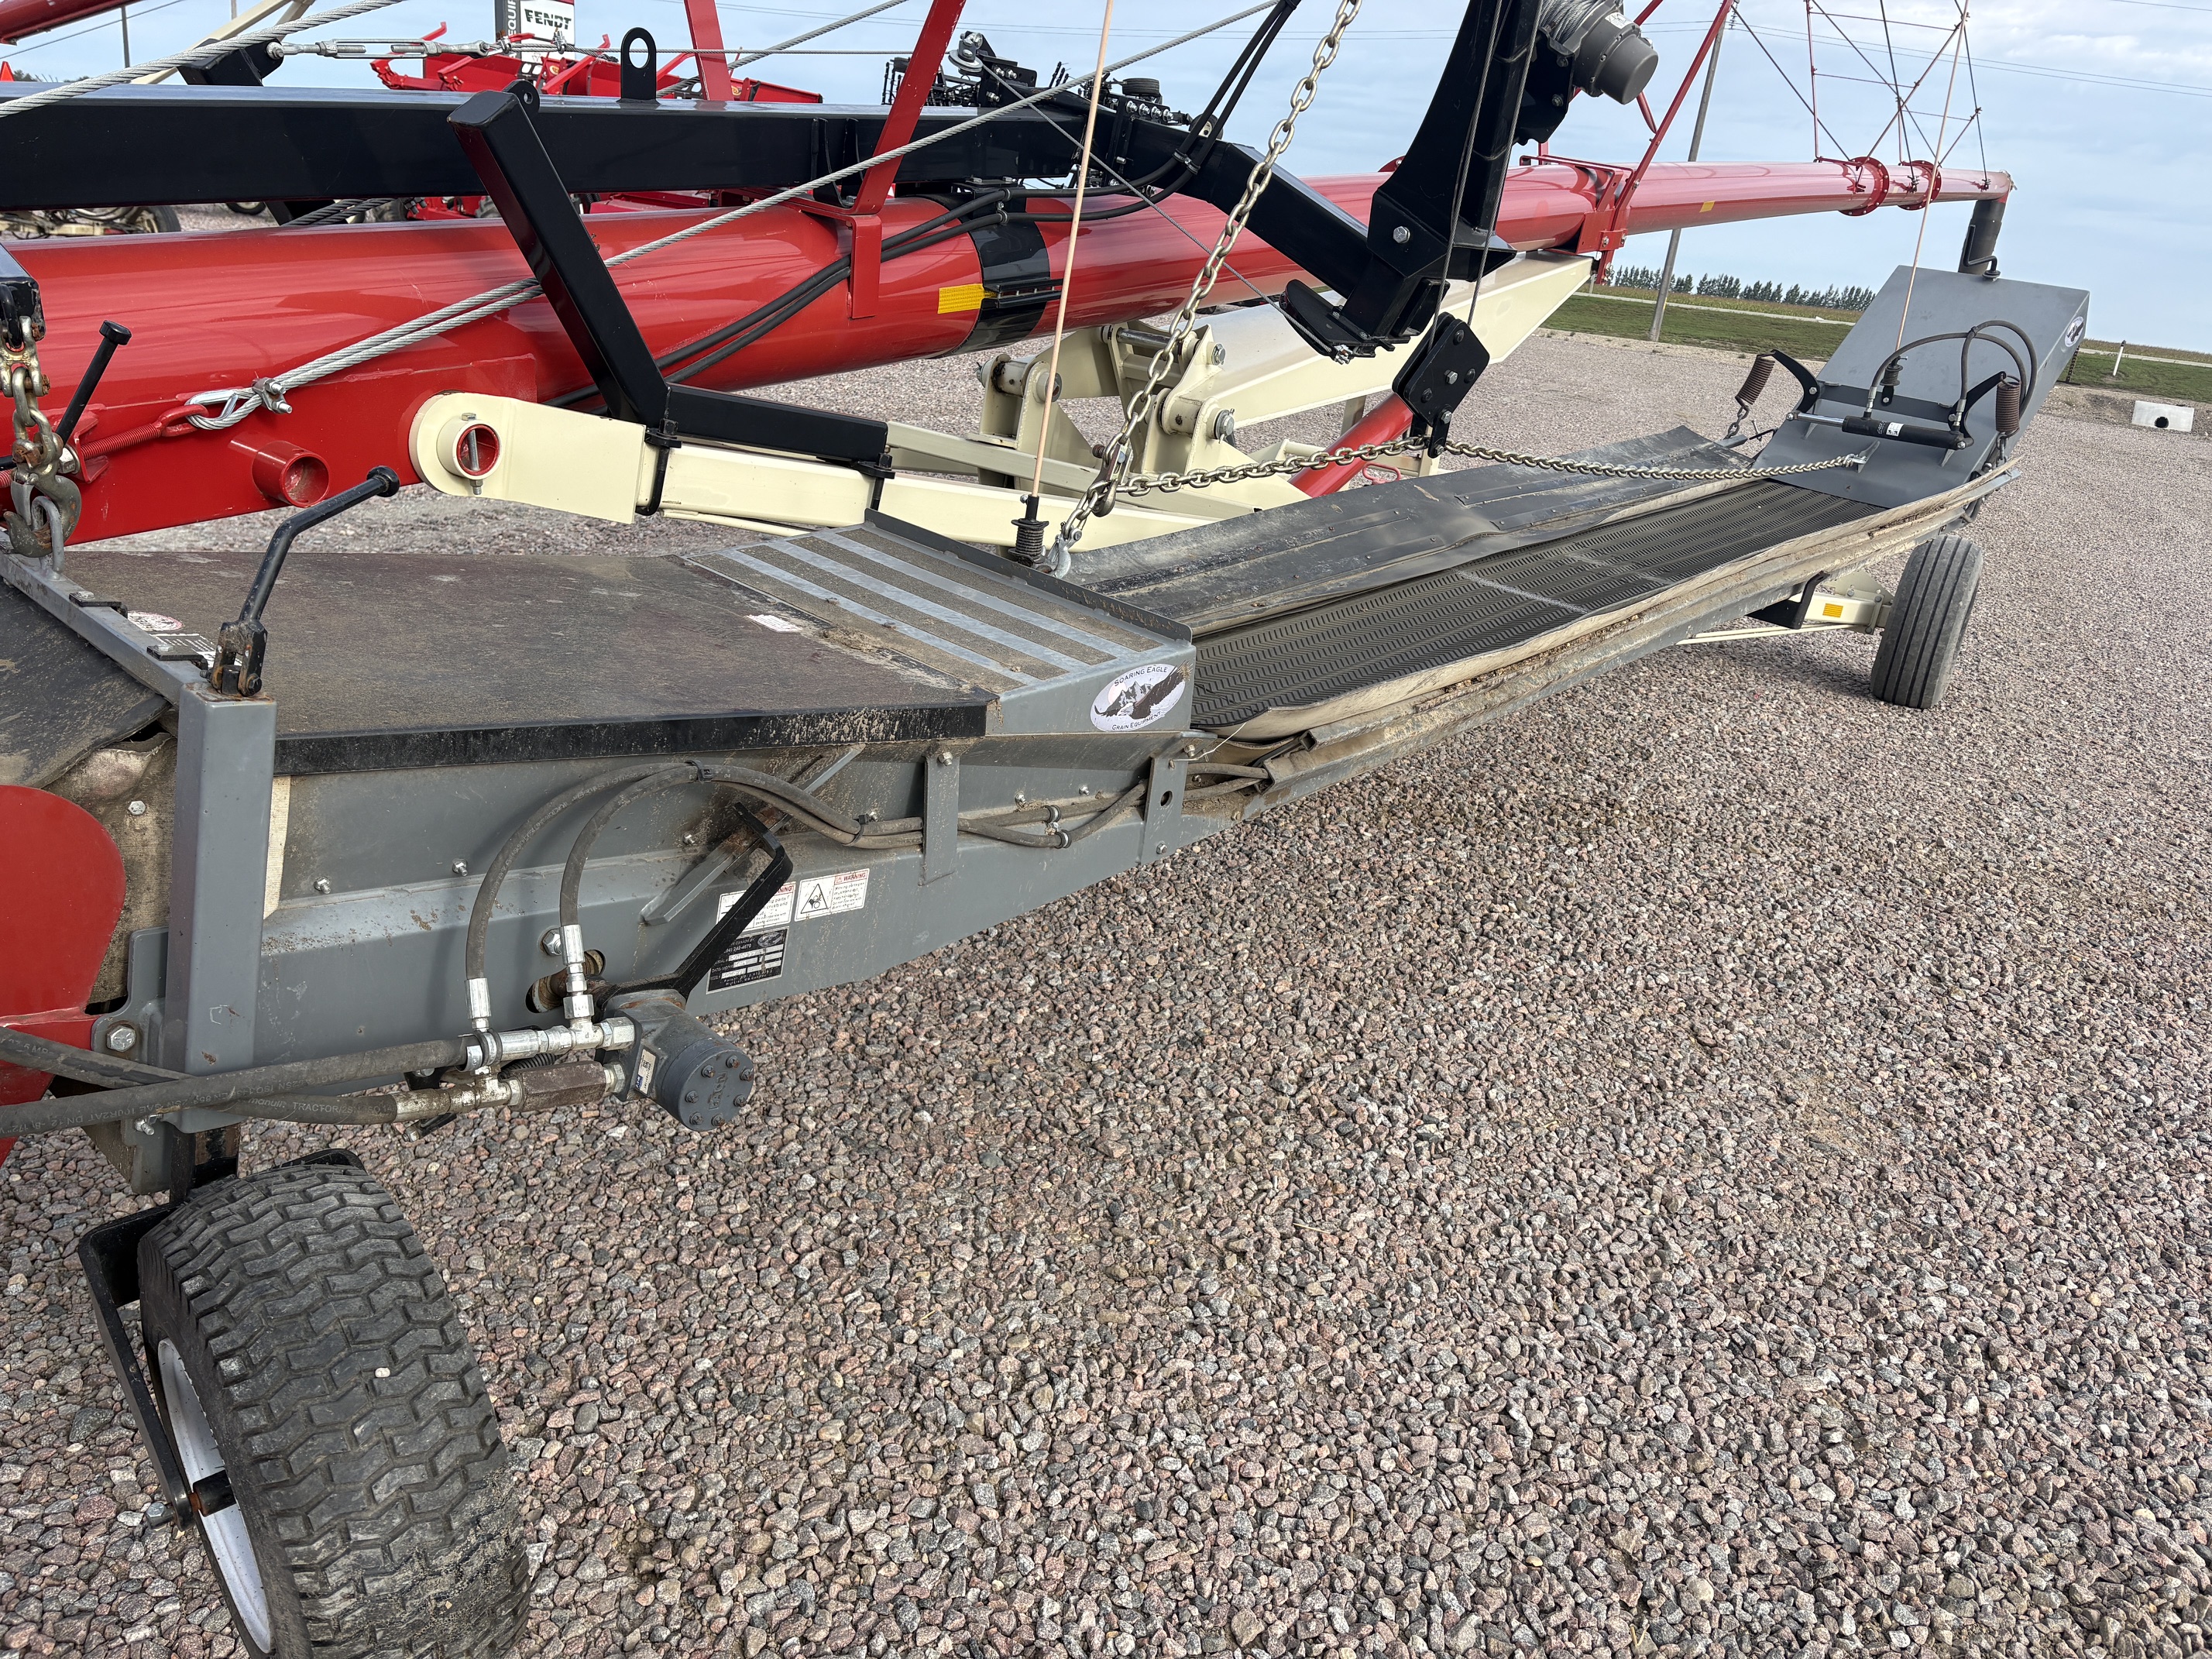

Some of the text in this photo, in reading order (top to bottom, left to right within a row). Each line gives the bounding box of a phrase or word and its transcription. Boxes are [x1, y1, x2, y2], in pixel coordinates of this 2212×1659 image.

[524, 9, 572, 30] FENDT
[1114, 668, 1146, 687] SOARING
[1130, 710, 1163, 728] EQUIPMENT
[843, 872, 866, 881] WARNING
